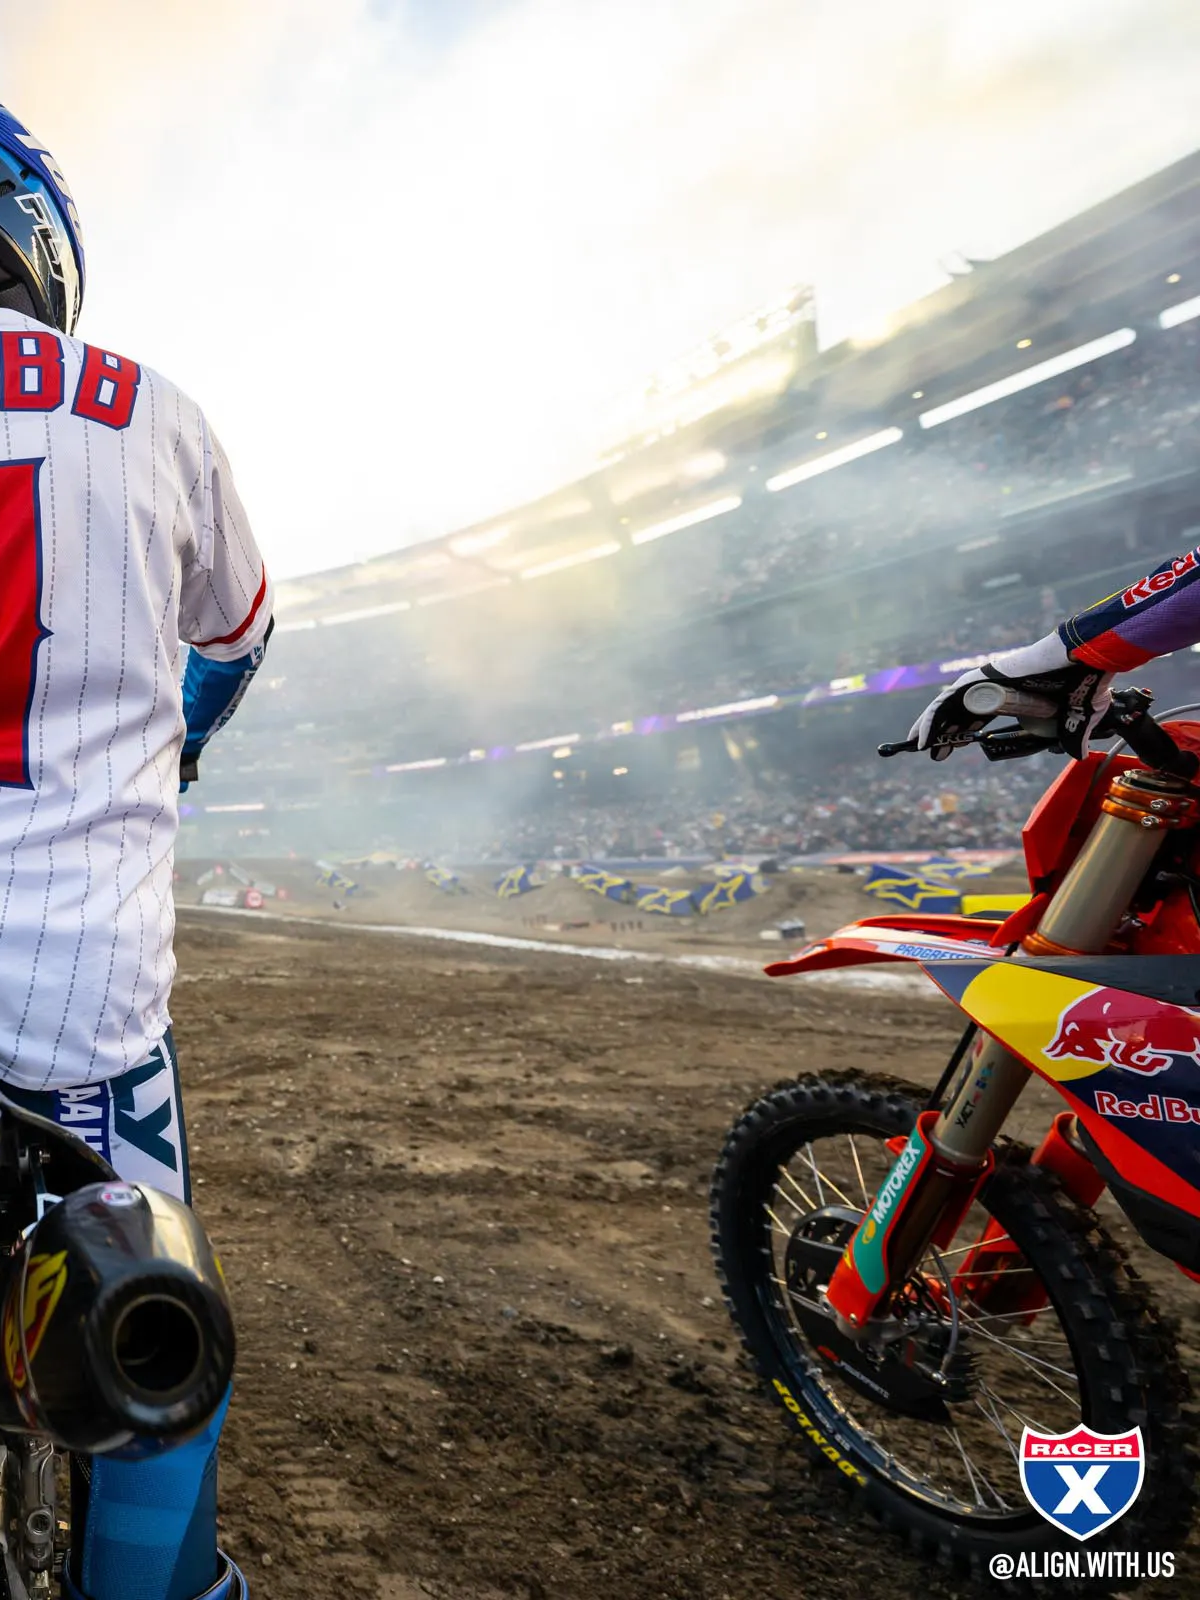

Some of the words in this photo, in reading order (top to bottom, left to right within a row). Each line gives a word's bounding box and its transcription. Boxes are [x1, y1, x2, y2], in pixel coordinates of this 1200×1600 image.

[1121, 550, 1199, 610] Red
[109, 1040, 178, 1173] LY
[1094, 1090, 1163, 1121] Red
[872, 1139, 921, 1225] MOTOREX
[772, 1378, 859, 1478] DUNLOP
